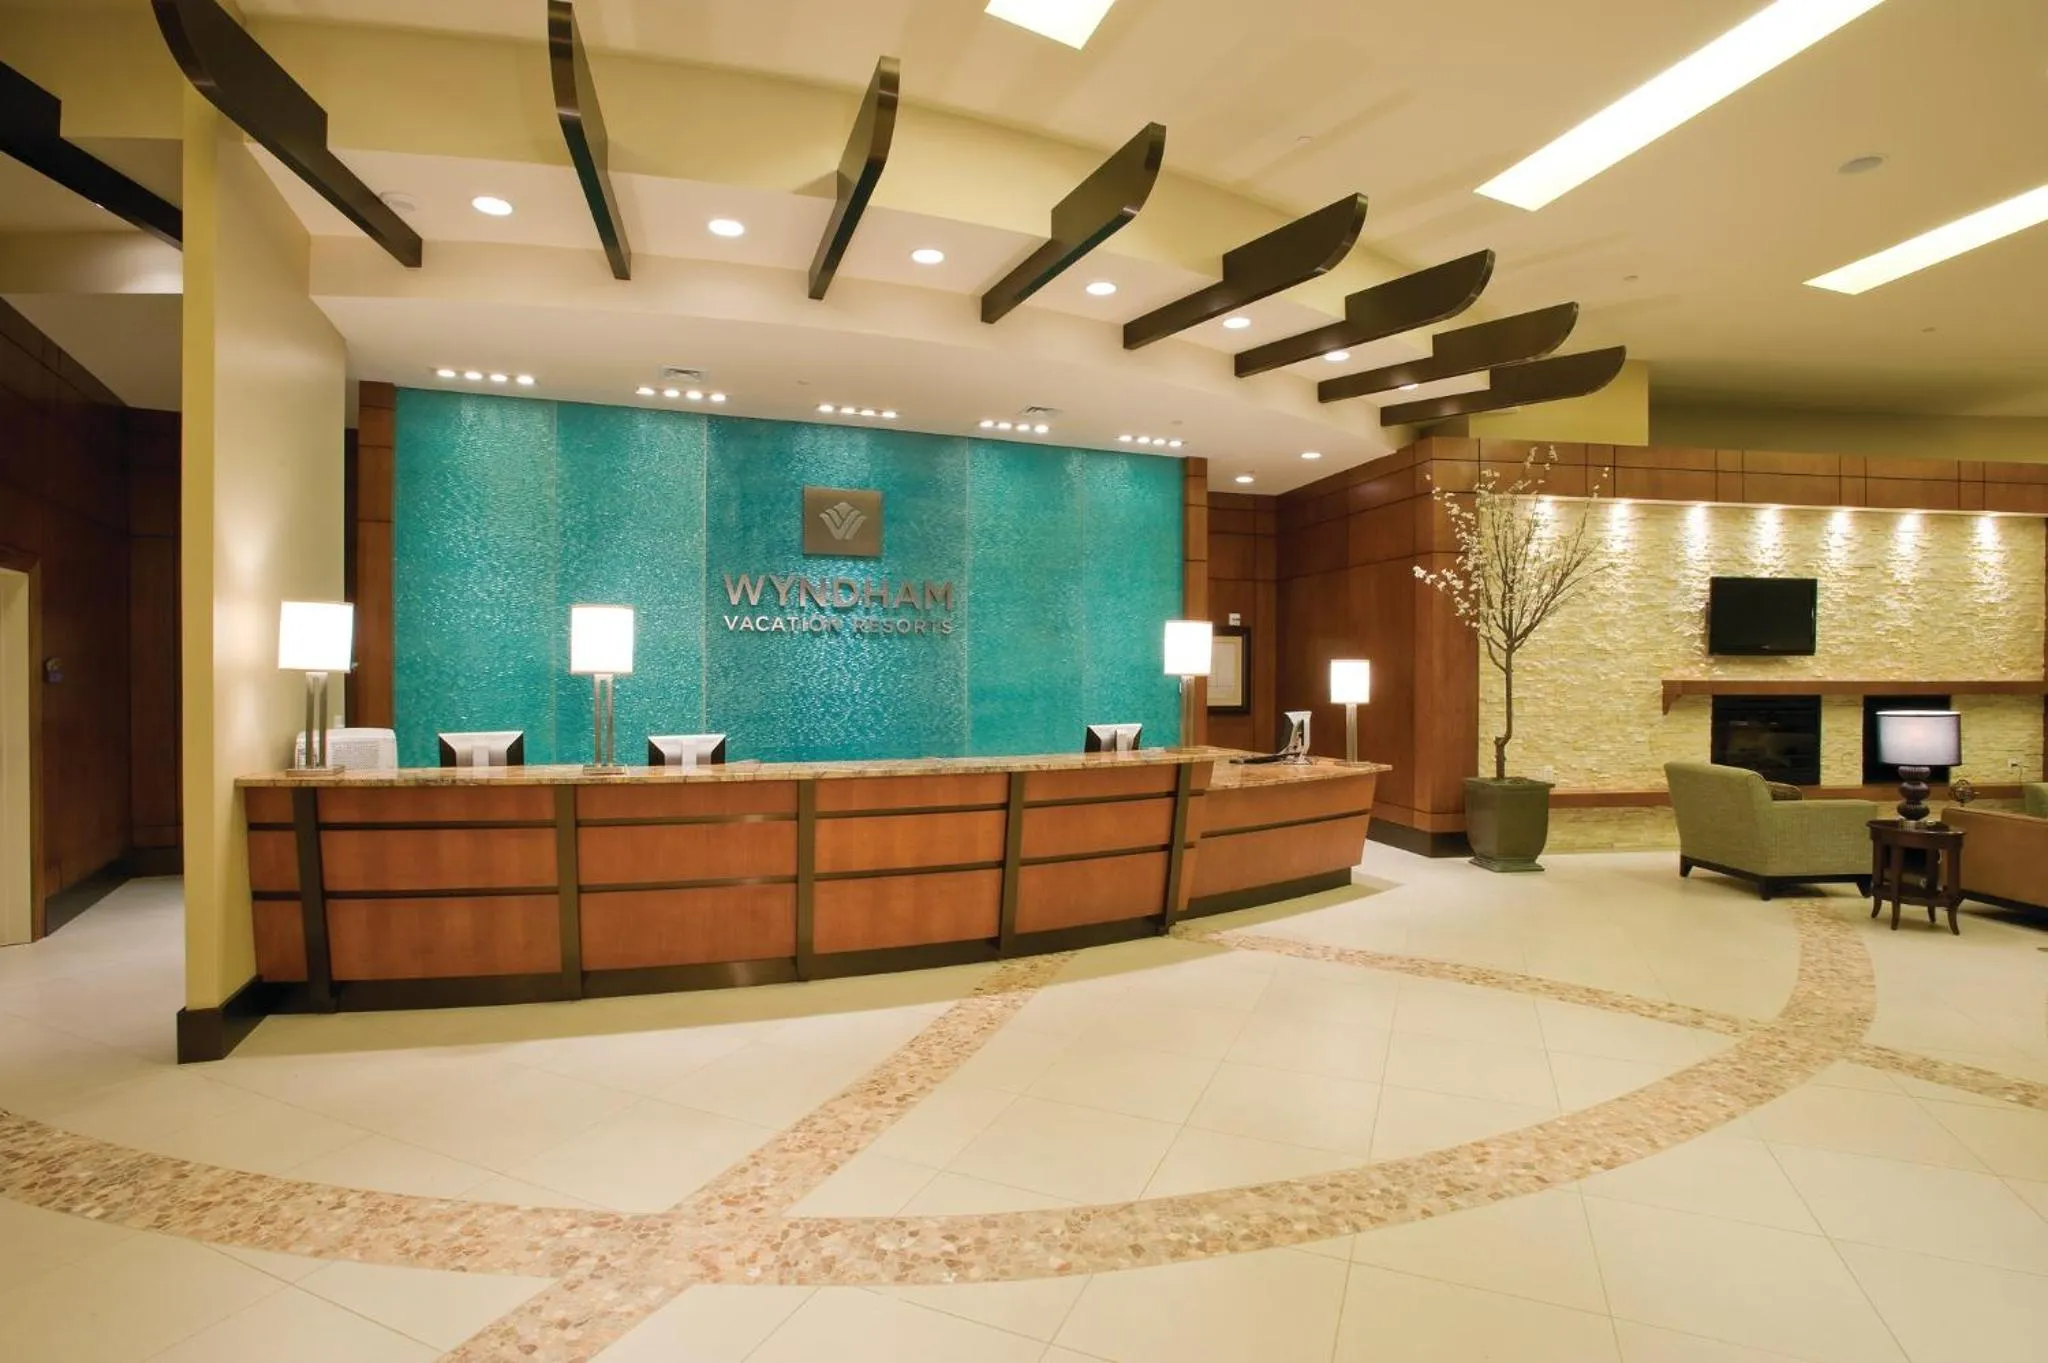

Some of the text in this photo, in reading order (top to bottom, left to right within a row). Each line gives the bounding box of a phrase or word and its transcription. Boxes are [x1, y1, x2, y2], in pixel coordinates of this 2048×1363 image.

[724, 574, 953, 610] WYNDHAM
[724, 615, 953, 634] VACATION RESORTS
